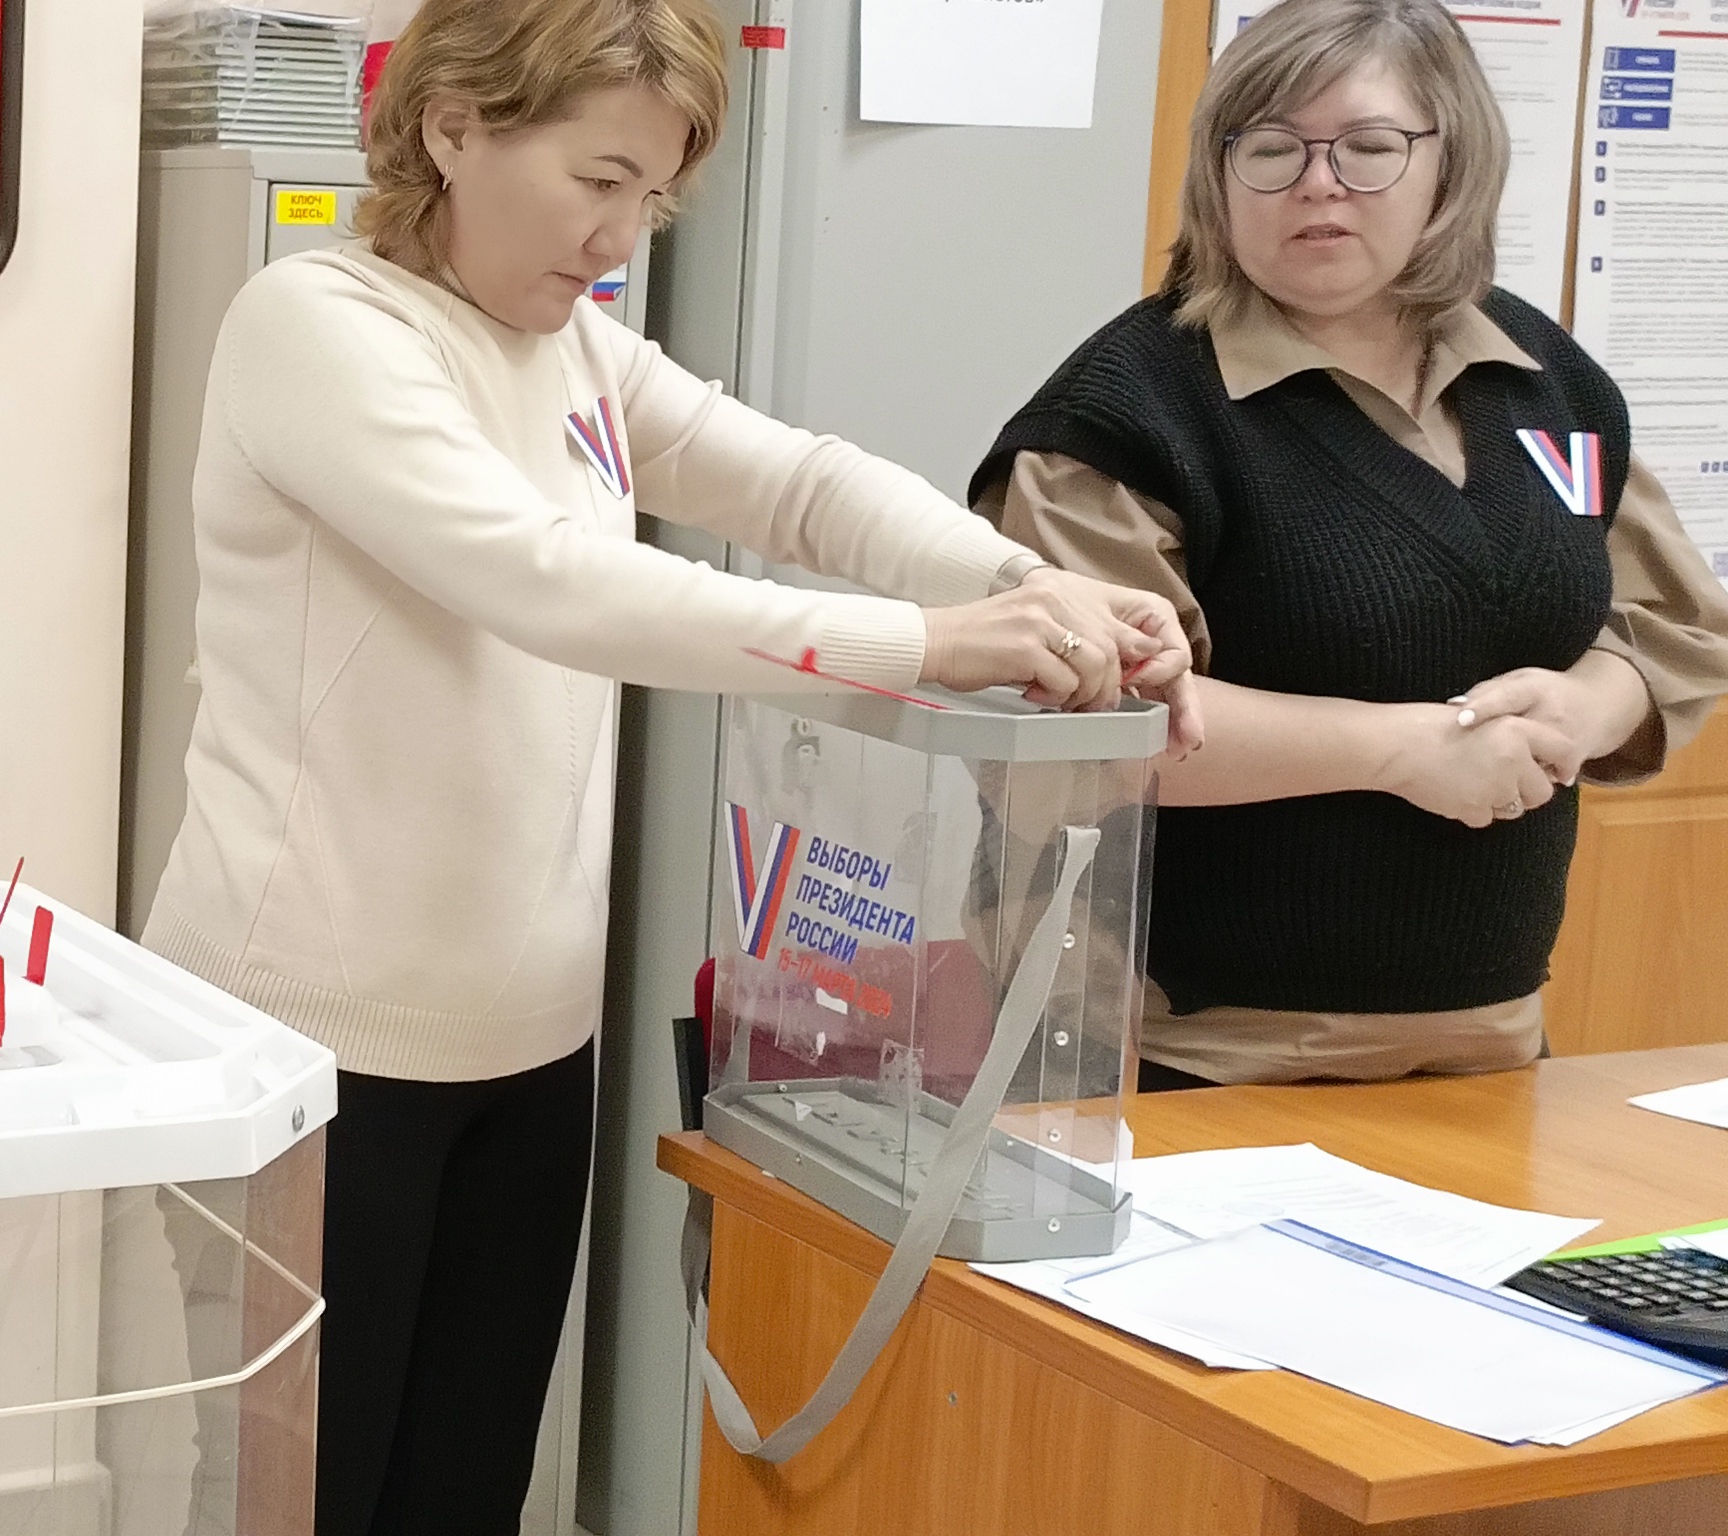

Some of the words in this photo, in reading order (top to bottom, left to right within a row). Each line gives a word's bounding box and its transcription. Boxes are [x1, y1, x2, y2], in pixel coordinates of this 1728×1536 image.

[287, 207, 324, 220] ЗДЕСЬ
[290, 194, 323, 206] КЛЮЧ
[805, 835, 892, 891] ВЫБОРЫ
[795, 873, 916, 945] ПРЕЗИДЕНТА
[784, 910, 859, 964] РОССИИ
